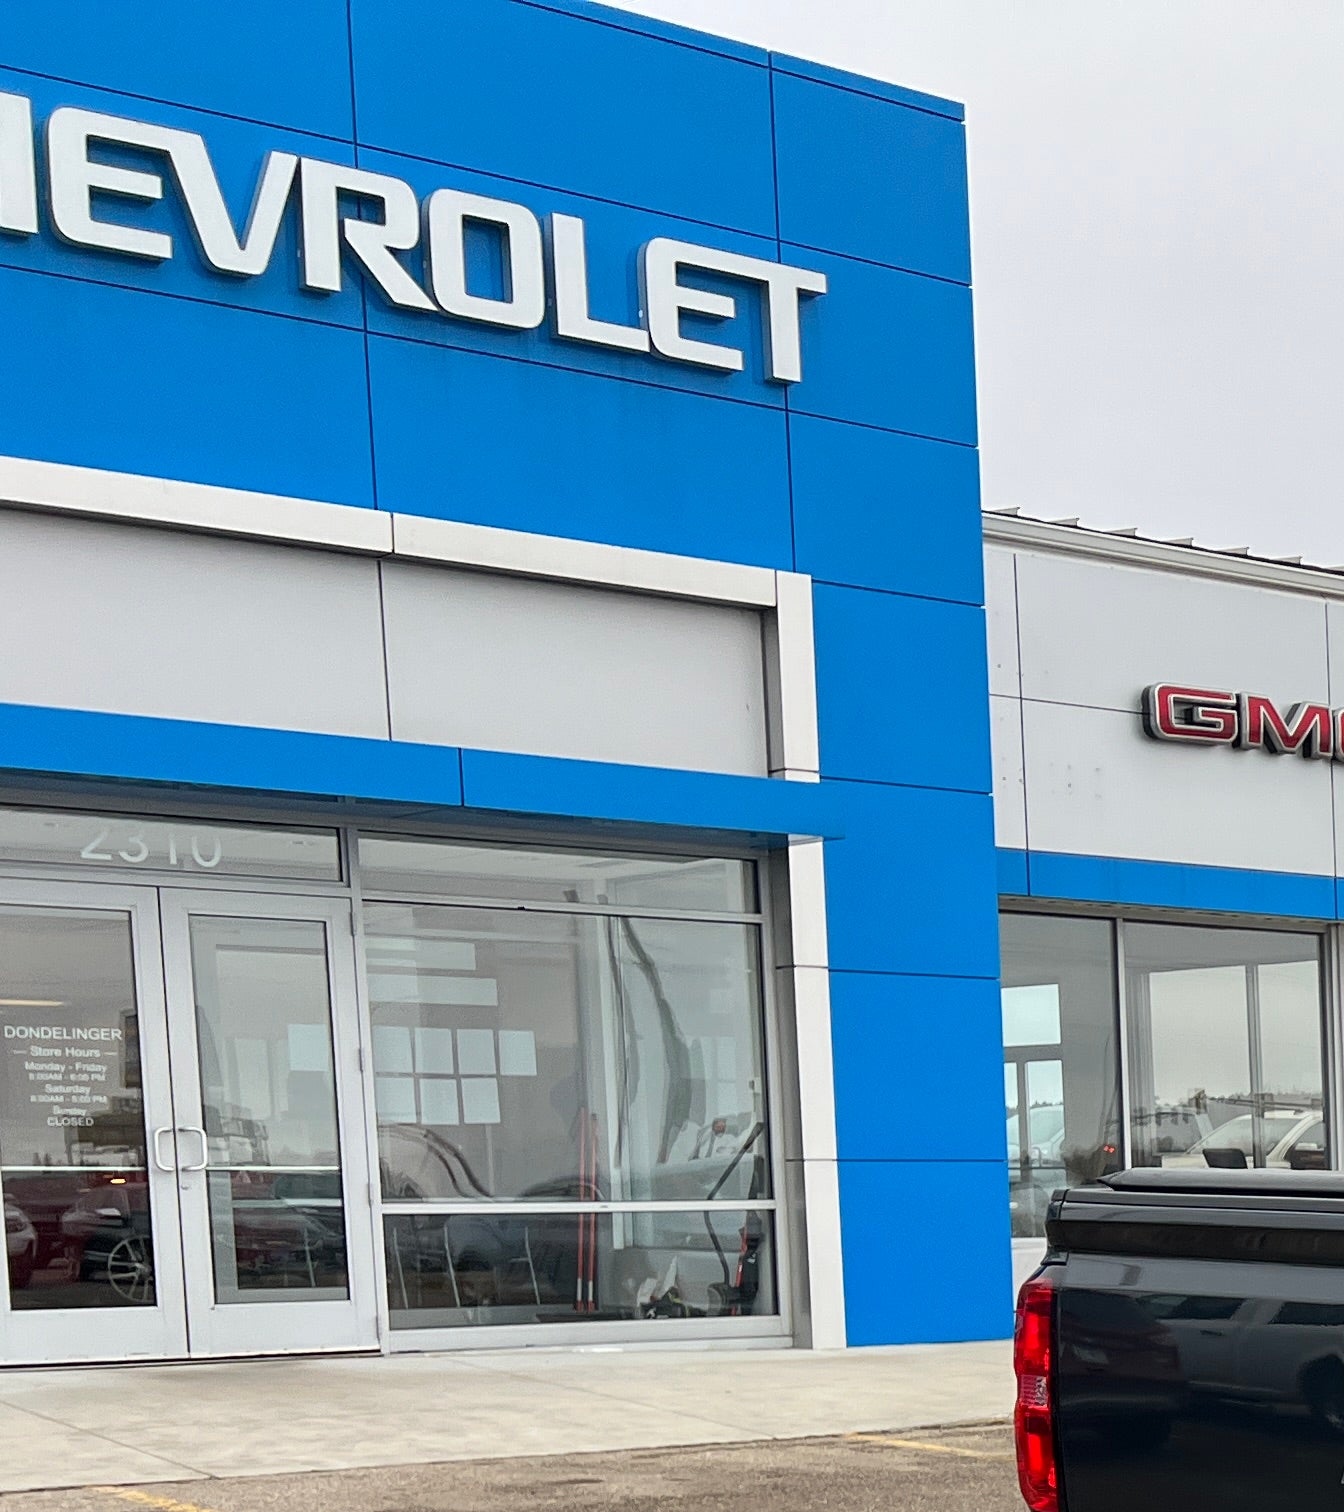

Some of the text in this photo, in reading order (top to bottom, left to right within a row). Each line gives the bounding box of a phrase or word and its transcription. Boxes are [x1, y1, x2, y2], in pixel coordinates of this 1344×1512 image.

[4, 1025, 122, 1040] DONDELINGER
[30, 1045, 101, 1058] Store Hours
[24, 1061, 66, 1072] Monday
[75, 1062, 107, 1073] Friday
[45, 1083, 91, 1096] Saturday
[47, 1116, 94, 1127] CLOSED
